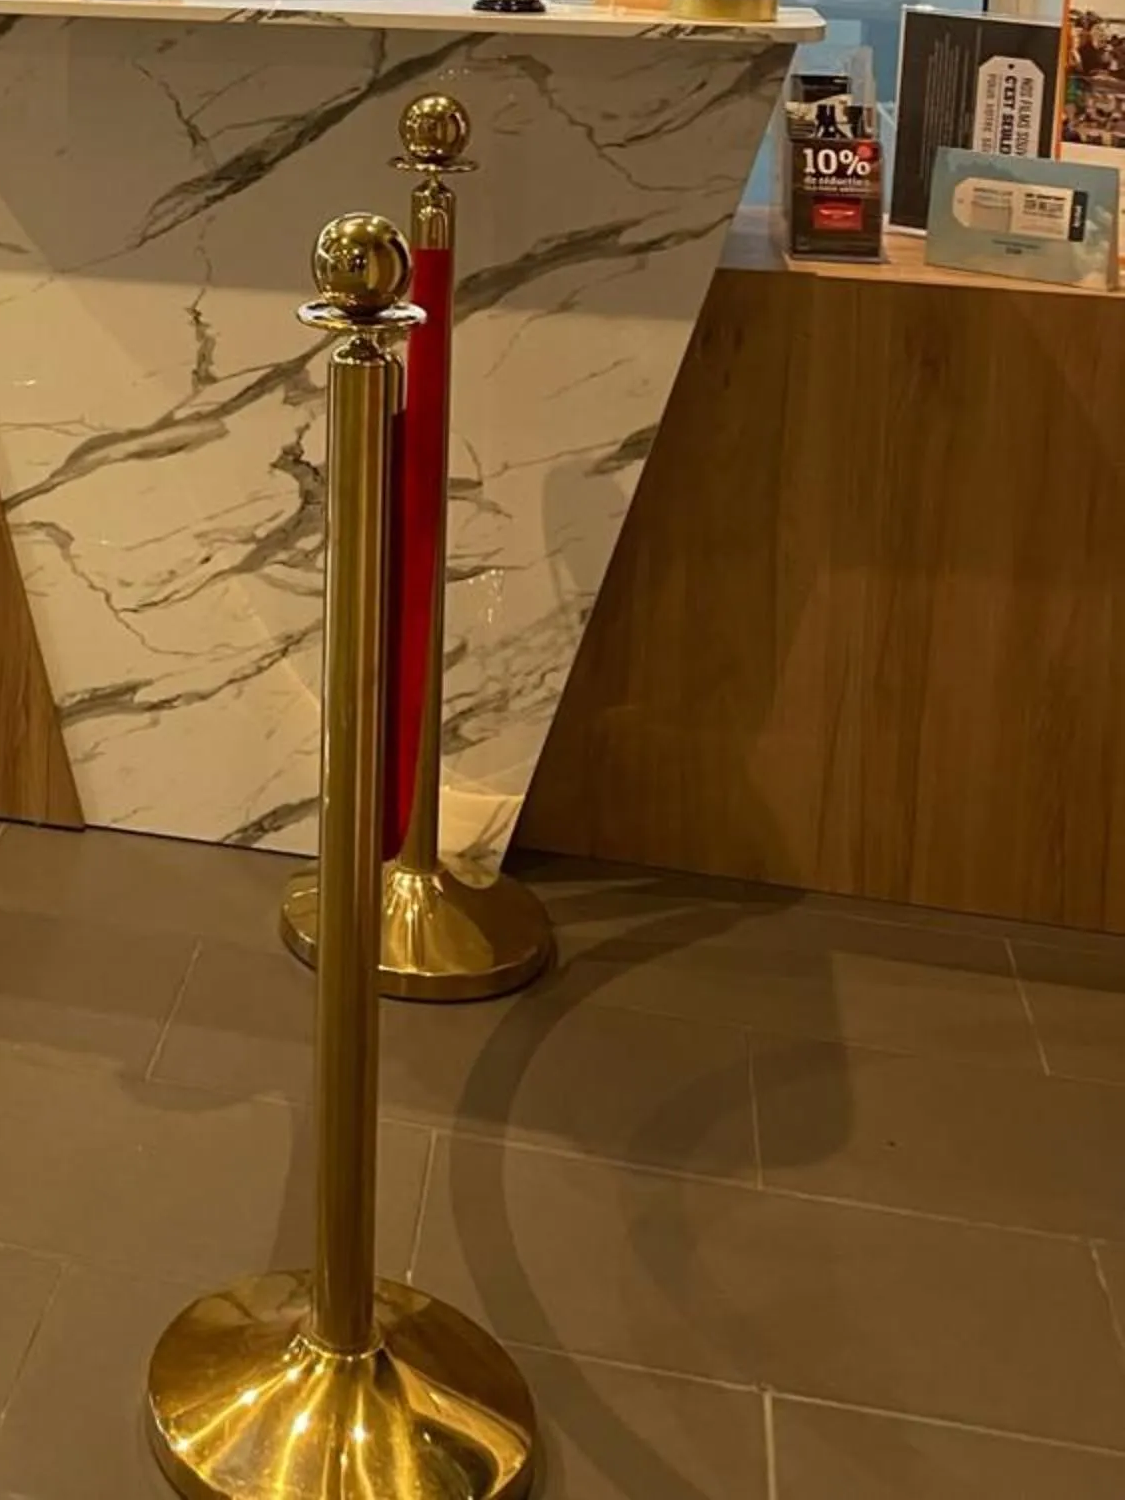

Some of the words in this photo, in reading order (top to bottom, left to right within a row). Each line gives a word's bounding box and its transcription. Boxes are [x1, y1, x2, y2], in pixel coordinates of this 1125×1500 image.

[1003, 75, 1017, 110] C'EST
[999, 114, 1014, 155] SEULE
[803, 148, 871, 175] 10%
